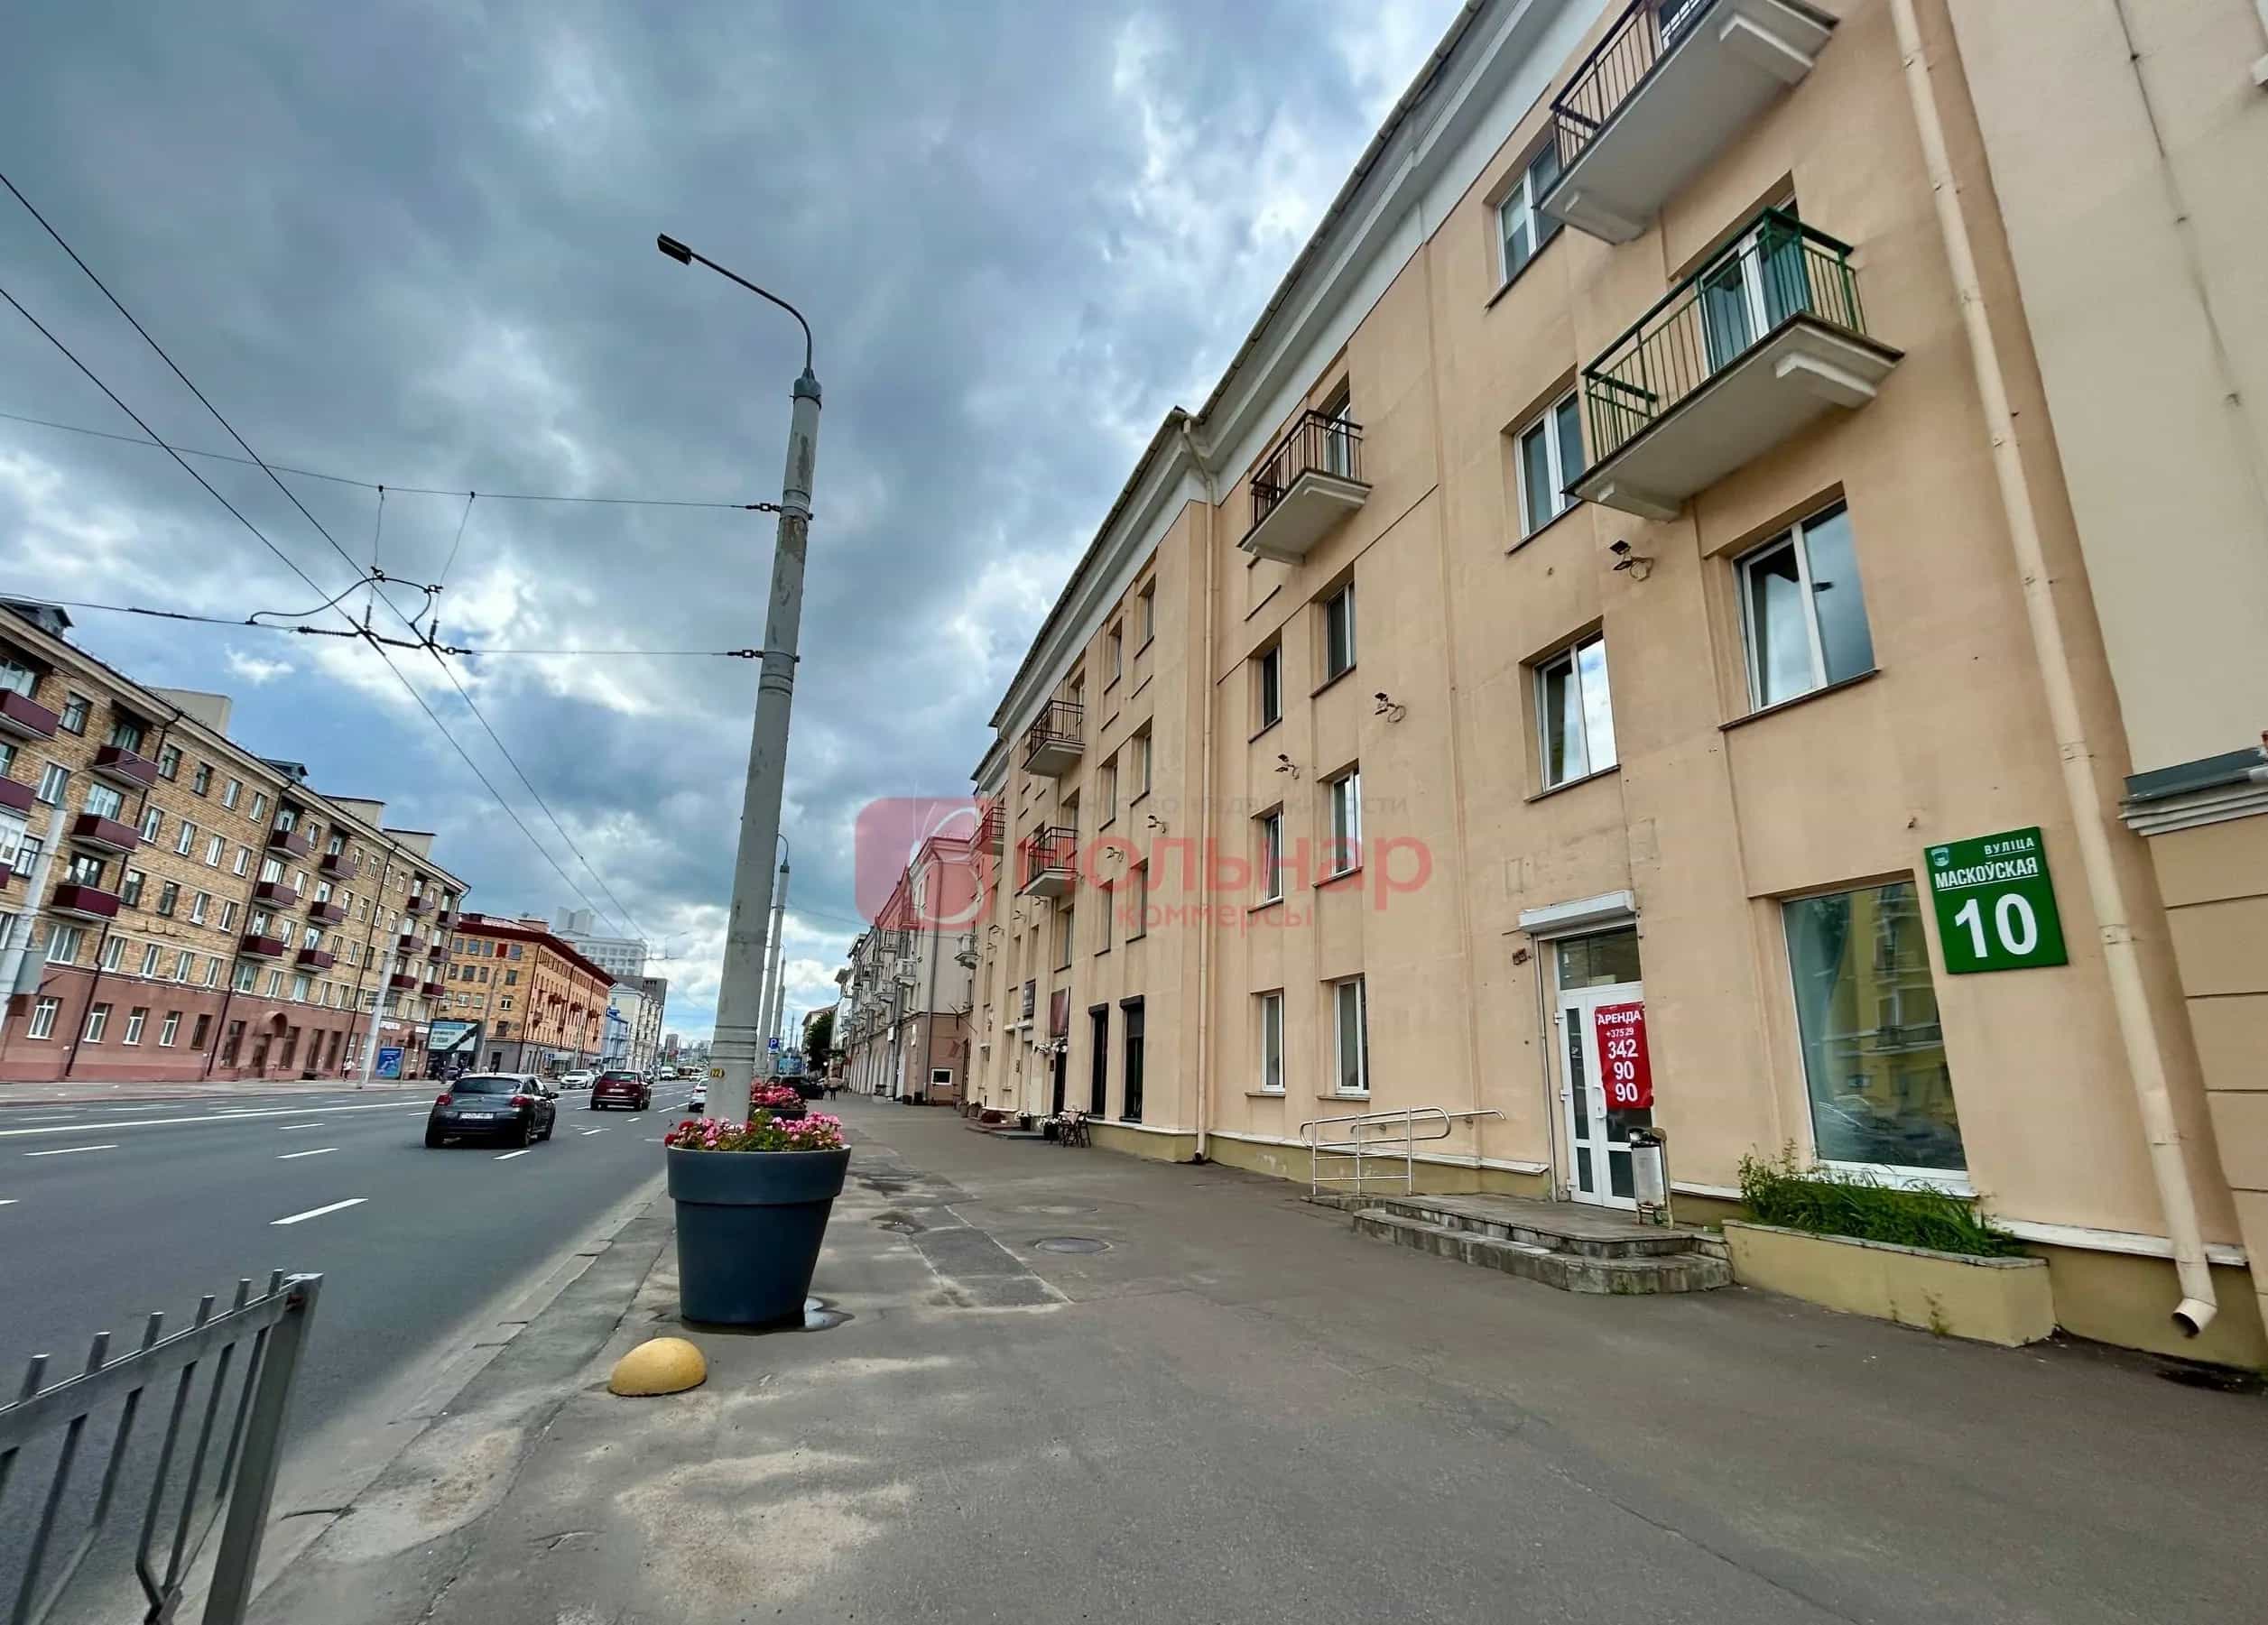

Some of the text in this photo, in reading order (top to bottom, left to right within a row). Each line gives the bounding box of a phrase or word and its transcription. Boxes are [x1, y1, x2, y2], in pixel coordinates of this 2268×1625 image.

[1984, 837, 2035, 855] ВУЛІЦА
[1934, 856, 2039, 889] МАСКОЎСКАЯ
[1955, 893, 2038, 958] 10
[1596, 1011, 1642, 1025] АРЕНДА
[1607, 1039, 1639, 1059] 342
[1613, 1061, 1634, 1080] 90
[1615, 1083, 1638, 1102] 90
